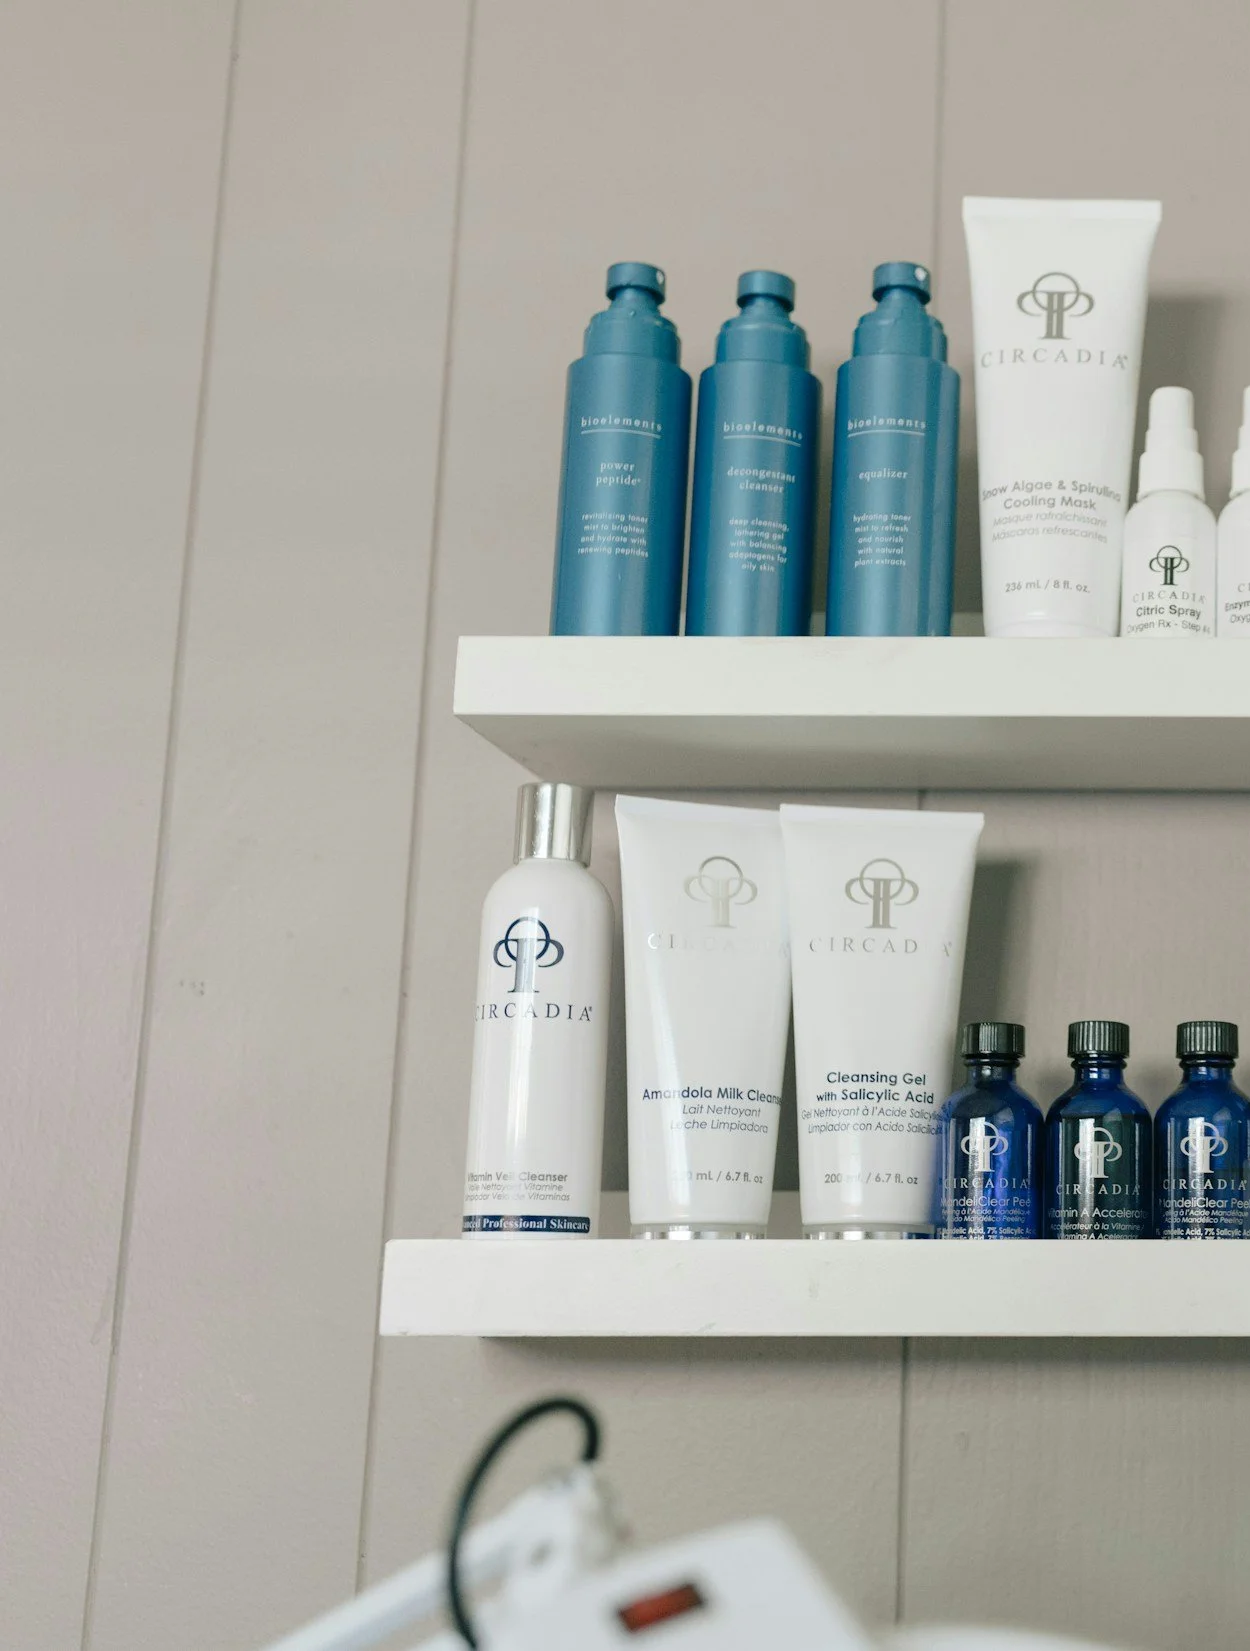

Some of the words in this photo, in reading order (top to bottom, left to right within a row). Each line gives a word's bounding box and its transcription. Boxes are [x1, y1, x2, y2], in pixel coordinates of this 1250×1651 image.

[980, 348, 1128, 370] CIRCADIA
[581, 414, 662, 432] bioelements
[847, 415, 927, 431] bioelements
[723, 420, 803, 440] bioelements
[600, 462, 635, 473] power
[727, 466, 796, 483] decongestant
[858, 467, 908, 482] equalizer
[739, 479, 784, 494] cleanser
[982, 484, 1008, 501] Snow
[1011, 480, 1053, 494] Algae
[1057, 480, 1067, 490] &
[1003, 496, 1056, 510] Cooling
[1060, 496, 1097, 510] Mask
[629, 513, 648, 524] toner
[729, 516, 749, 526] deep
[852, 512, 889, 523] hydrating
[890, 512, 912, 521] toner
[993, 512, 1034, 527] Masque
[584, 523, 598, 531] mist
[601, 523, 609, 531] to
[611, 522, 645, 534] brighten
[734, 528, 770, 540] lathering
[772, 532, 784, 541] gel
[855, 524, 869, 533] mist
[871, 524, 879, 532] to
[881, 523, 908, 533] refresh
[1042, 525, 1108, 543] refrescantes
[580, 533, 594, 543] and
[597, 533, 627, 543] hydrate
[631, 536, 646, 546] with
[857, 535, 872, 544] and
[874, 534, 904, 543] nourish
[578, 545, 612, 555] renewing
[615, 546, 648, 558] peptides
[730, 539, 746, 548] with
[749, 539, 787, 554] balancing
[857, 546, 873, 555] with
[875, 546, 904, 555] natural
[729, 550, 775, 562] adaptogens
[777, 553, 788, 564] for
[854, 557, 873, 568] plant
[875, 557, 906, 567] extracts
[741, 562, 757, 572] oily
[760, 562, 775, 573] skin
[1005, 582, 1023, 593] 236
[1053, 580, 1060, 588] 8
[1136, 605, 1165, 618] Citric
[1169, 604, 1202, 620] Spray
[1158, 619, 1171, 629] Rx
[1181, 620, 1200, 633] Step
[827, 1071, 897, 1086] Cleansing
[902, 1072, 926, 1085] Gel
[642, 1086, 712, 1101] Amandola
[717, 1087, 743, 1100] Milk
[816, 1091, 837, 1102] with
[841, 1088, 900, 1103] Salicylic
[905, 1090, 934, 1104] Acid
[682, 1104, 704, 1115] Lait
[706, 1104, 761, 1118] Nettoyant
[801, 1108, 812, 1120] Gel
[813, 1106, 859, 1120] Nettoyant
[862, 1105, 869, 1117] à
[871, 1106, 906, 1118] l'Acide
[711, 1119, 768, 1134] Limpiadora
[808, 1121, 850, 1135] Limpiador
[852, 1122, 872, 1131] con
[518, 1171, 568, 1182] Cleanser
[696, 1170, 713, 1181] mL
[725, 1171, 741, 1182] 6.7
[753, 1175, 763, 1184] oz
[824, 1173, 842, 1184] 200
[875, 1173, 892, 1184] 6.7
[906, 1176, 918, 1184] oz
[524, 1182, 563, 1191] Vitamine
[1056, 1183, 1140, 1195] CIRCADIA
[1163, 1178, 1246, 1191] CIRCADIA
[528, 1192, 570, 1201] Vitaminas
[1231, 1197, 1250, 1208] Peel
[1080, 1207, 1090, 1218] A
[482, 1217, 546, 1230] Professional
[1094, 1221, 1100, 1230] à
[1102, 1221, 1110, 1230] la
